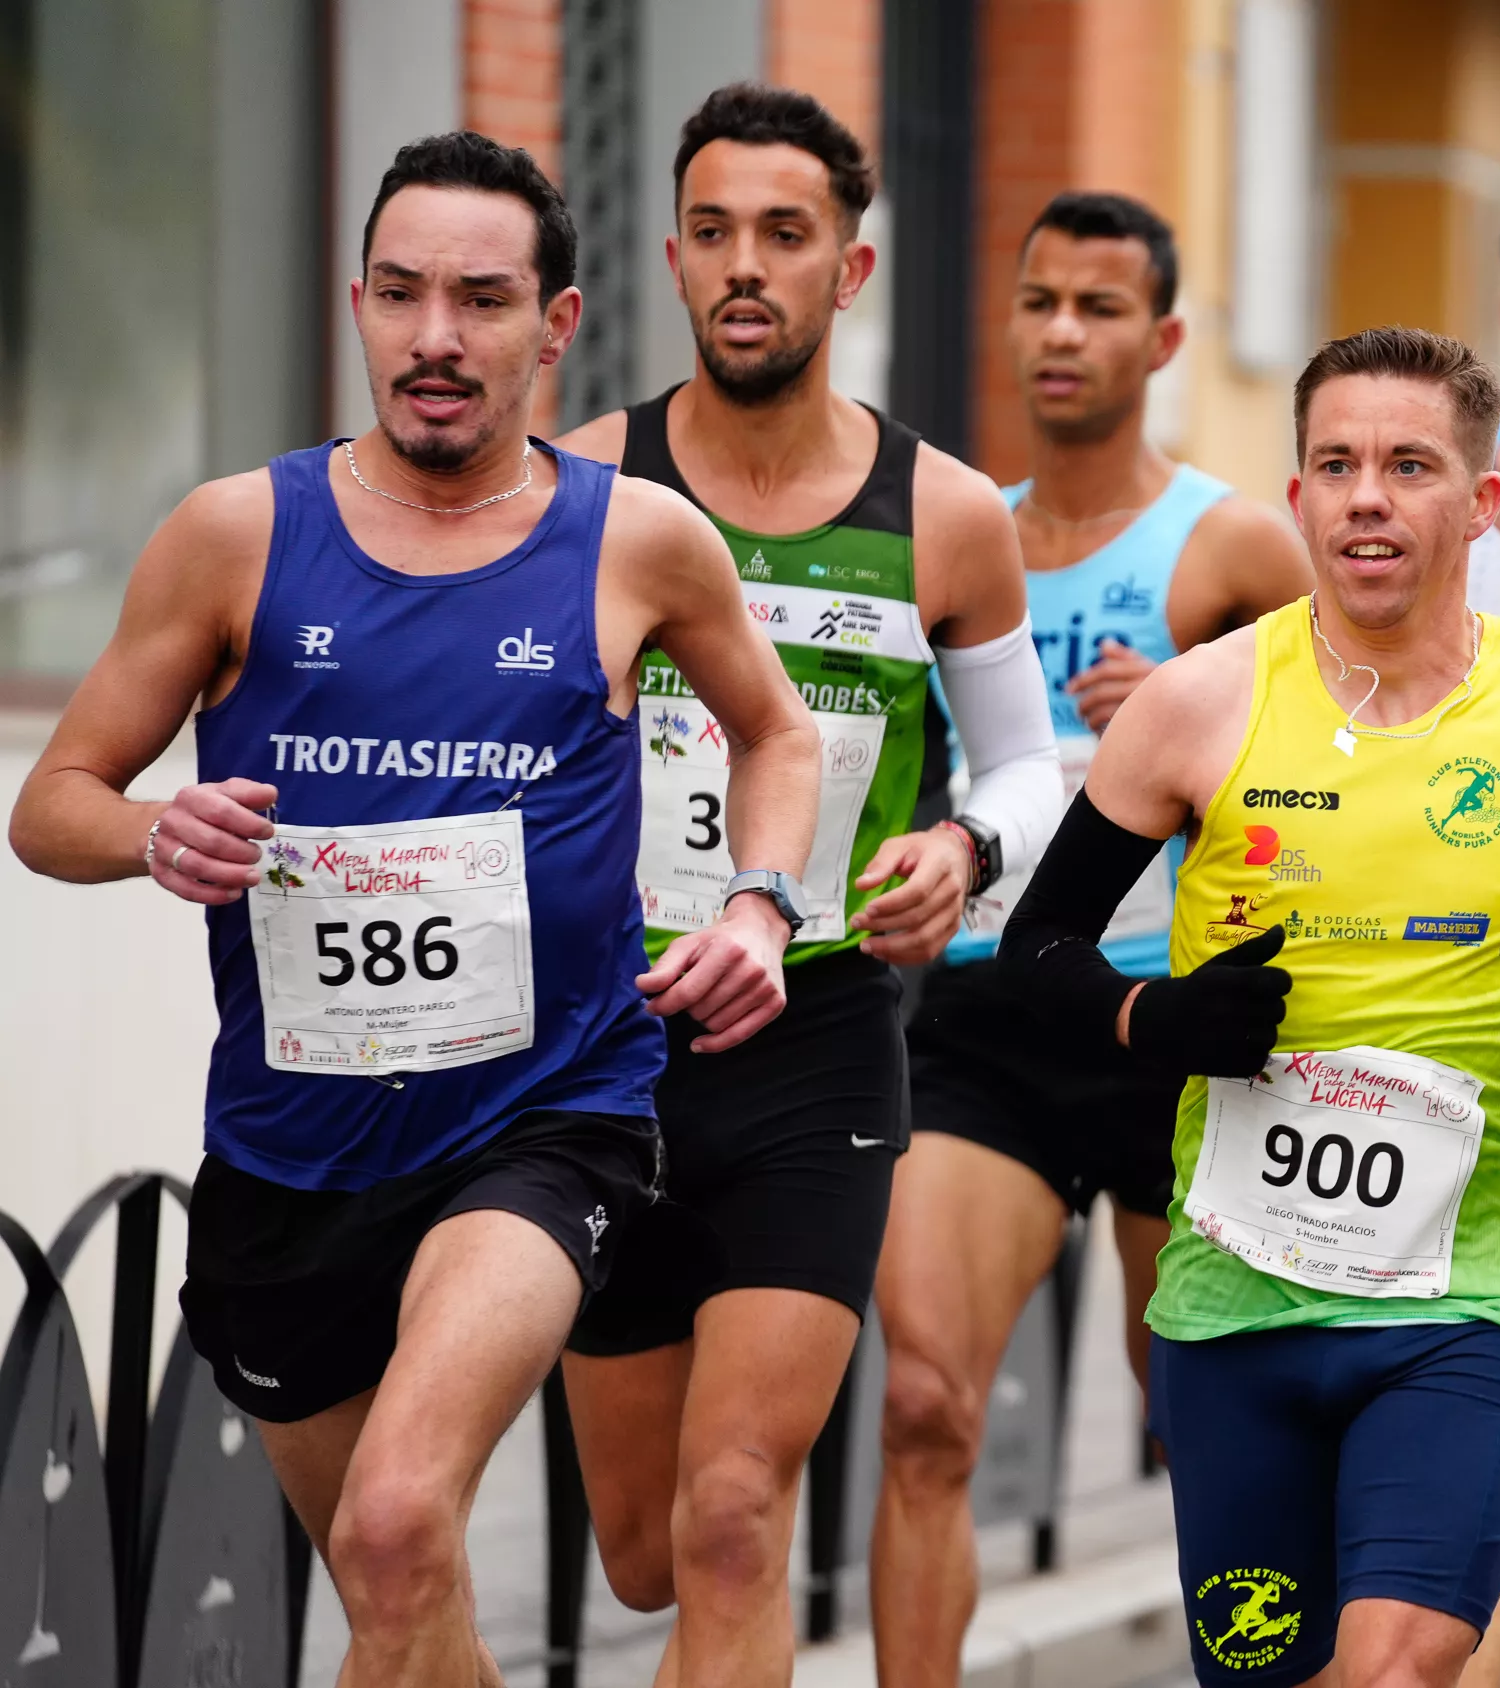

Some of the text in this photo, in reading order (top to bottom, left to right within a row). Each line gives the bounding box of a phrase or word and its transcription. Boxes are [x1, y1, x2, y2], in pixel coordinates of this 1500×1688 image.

[826, 565, 851, 579] LSC
[269, 733, 558, 781] TROTASIERRA
[1427, 762, 1452, 788] CLUB
[1424, 806, 1461, 848] RUNNERS
[1464, 834, 1493, 849] PURA
[1451, 830, 1485, 839] MORILES
[1281, 849, 1307, 867] DS
[345, 870, 434, 894] LUCENA
[673, 866, 728, 884] JUAN IGNACIO
[1267, 864, 1323, 882] Smith
[1314, 915, 1381, 926] BODEGAS
[1305, 926, 1388, 941] EL MONTE
[315, 915, 459, 988] 586
[324, 1001, 456, 1017] ANTONIO MONTERO PAREJO
[1351, 1067, 1419, 1096] MARATÓN
[1309, 1080, 1397, 1116] LUCENA
[1262, 1124, 1404, 1207] 900
[1266, 1205, 1376, 1237] DIEGO TIRADO PALACIOS
[1296, 1227, 1339, 1245] S-Hombre
[1196, 1568, 1298, 1599] CLUB ATLETISMO
[1196, 1610, 1302, 1670] RUNNERS PURA CEPA
[1229, 1644, 1274, 1660] MORILES
